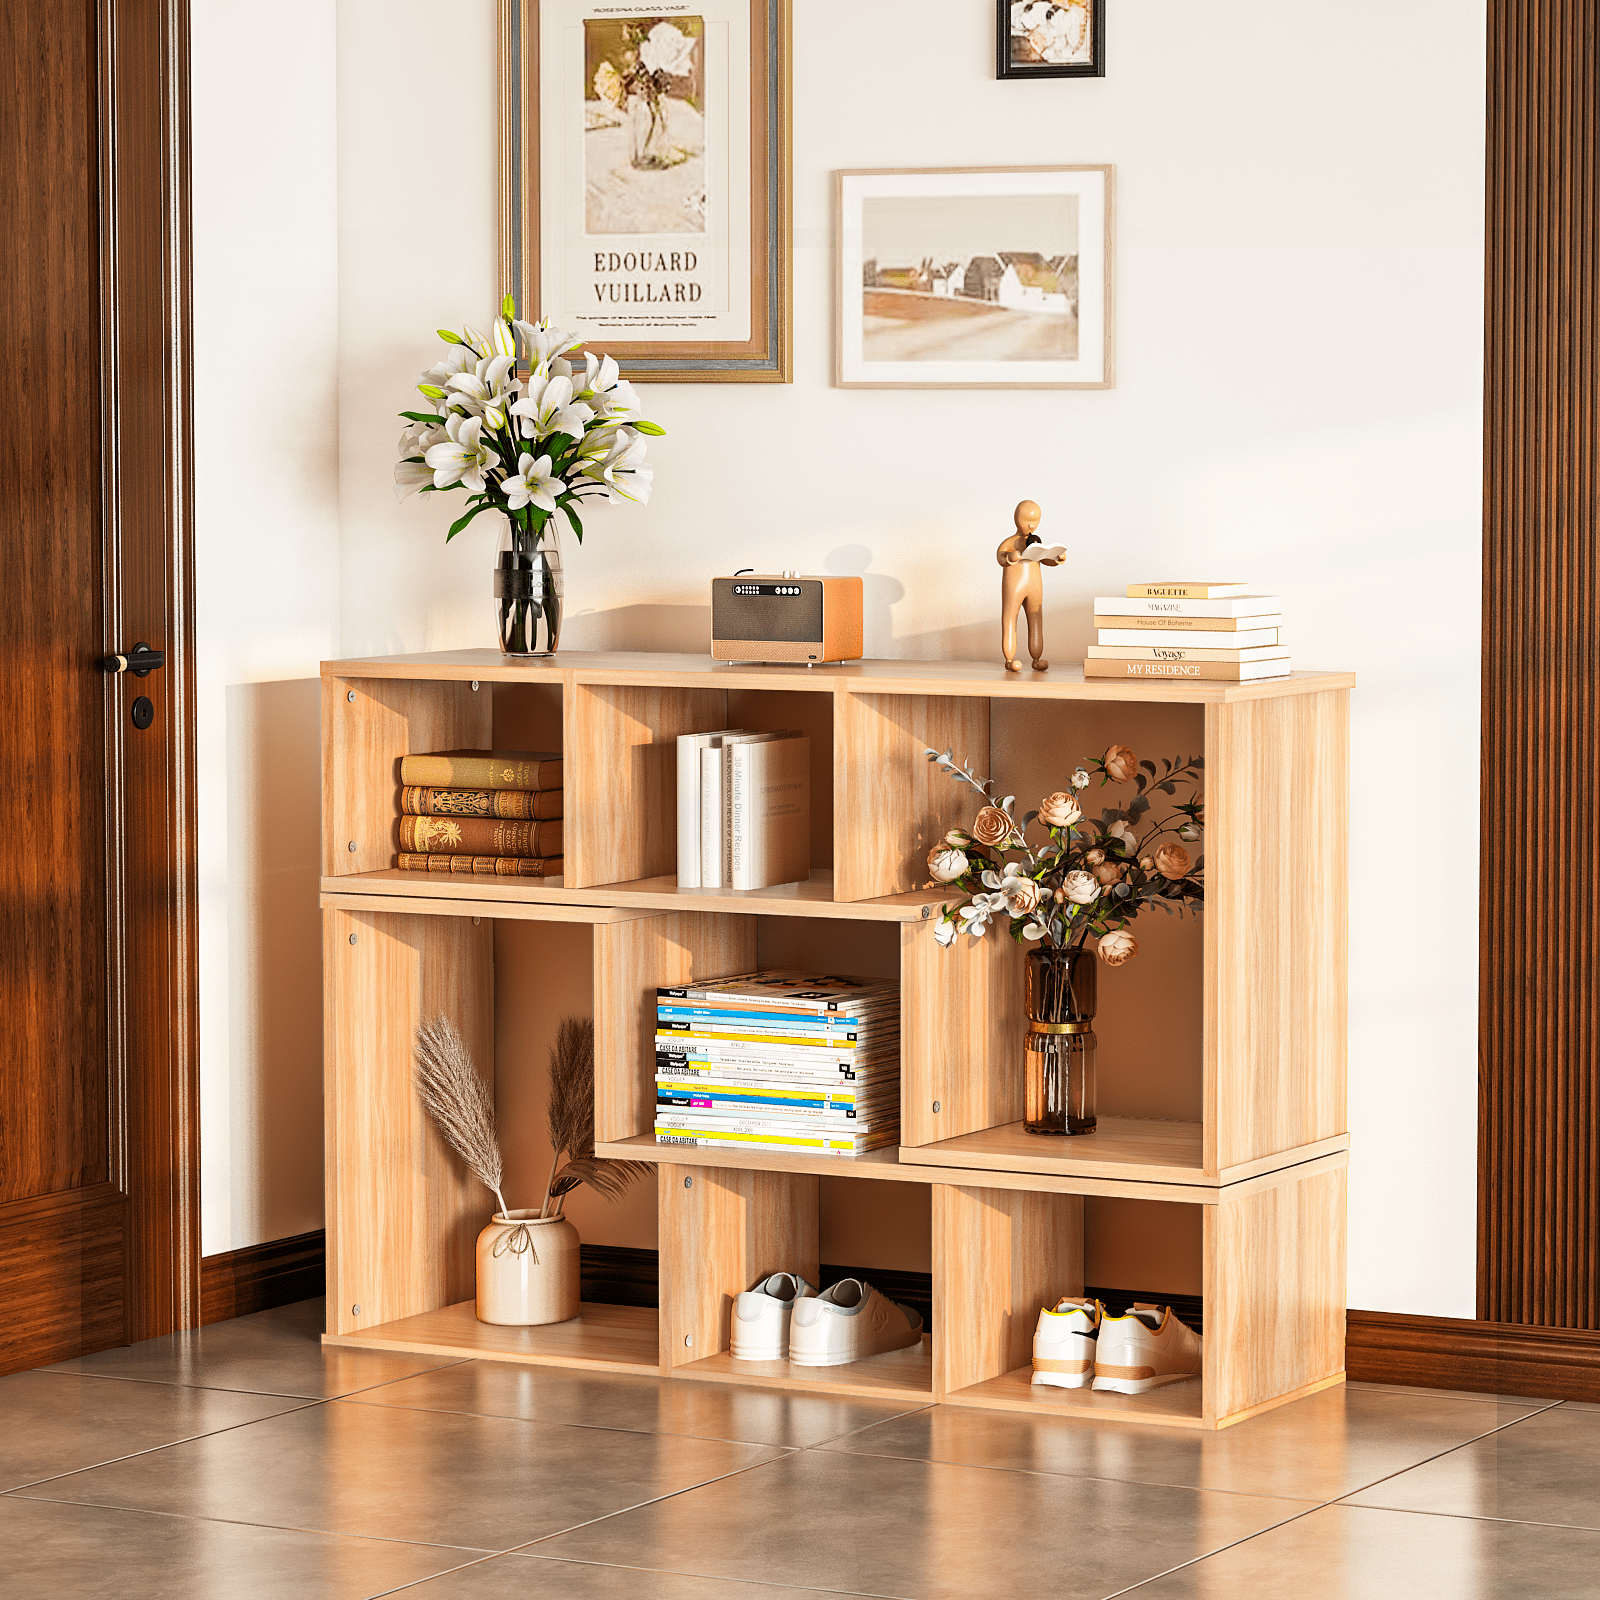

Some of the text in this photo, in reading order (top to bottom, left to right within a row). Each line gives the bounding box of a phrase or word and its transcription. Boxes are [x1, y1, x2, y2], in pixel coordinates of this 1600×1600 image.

[594, 252, 698, 272] EDOUARD
[595, 282, 702, 303] VUILLARD
[1147, 588, 1188, 596] BAGUETTE
[1153, 648, 1186, 660] Voyage
[1127, 664, 1200, 676] MY RESIDENCE
[733, 756, 742, 872] 30-Minute Dinner Recipes
